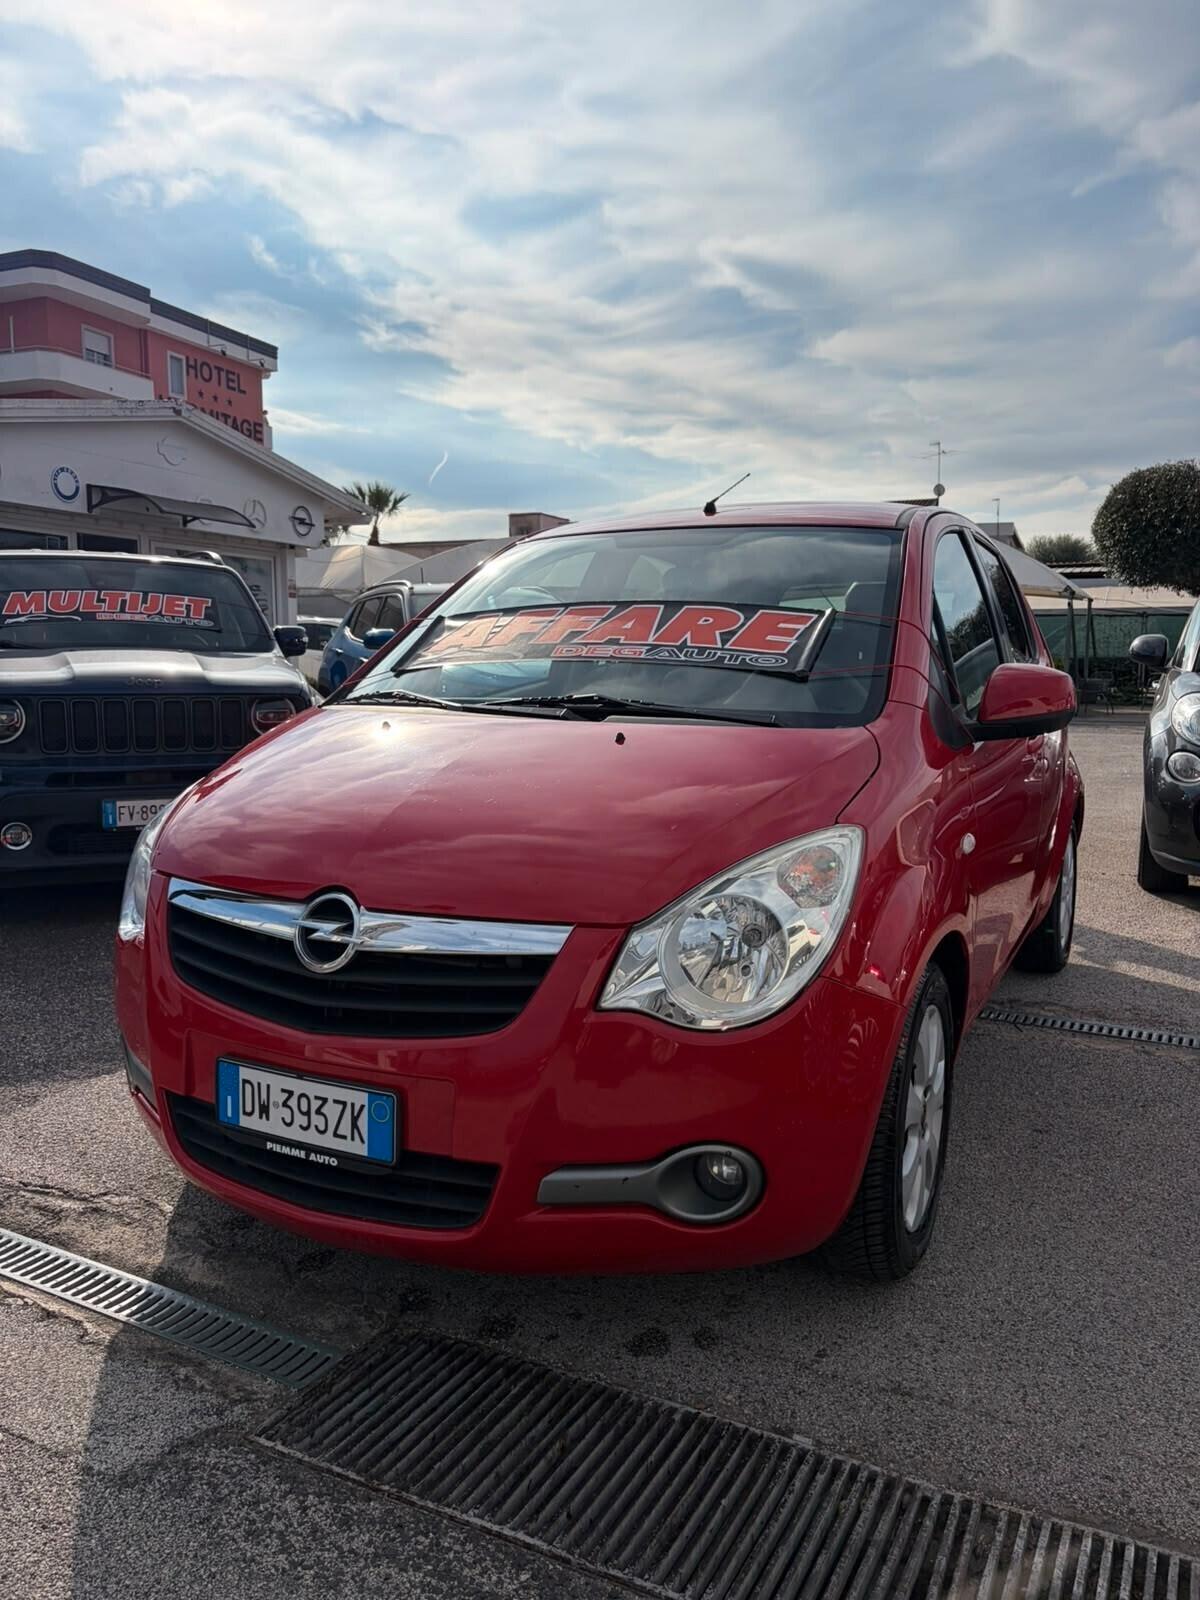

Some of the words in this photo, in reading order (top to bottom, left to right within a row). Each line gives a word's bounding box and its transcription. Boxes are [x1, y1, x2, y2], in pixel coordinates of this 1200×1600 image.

[186, 356, 247, 395] HOTEL
[2, 590, 212, 619] MULTIJET
[428, 604, 819, 655] AFFARE
[551, 644, 789, 668] DEGAUTO
[266, 1141, 306, 1160] PIEMME
[309, 1153, 338, 1167] AUTO
